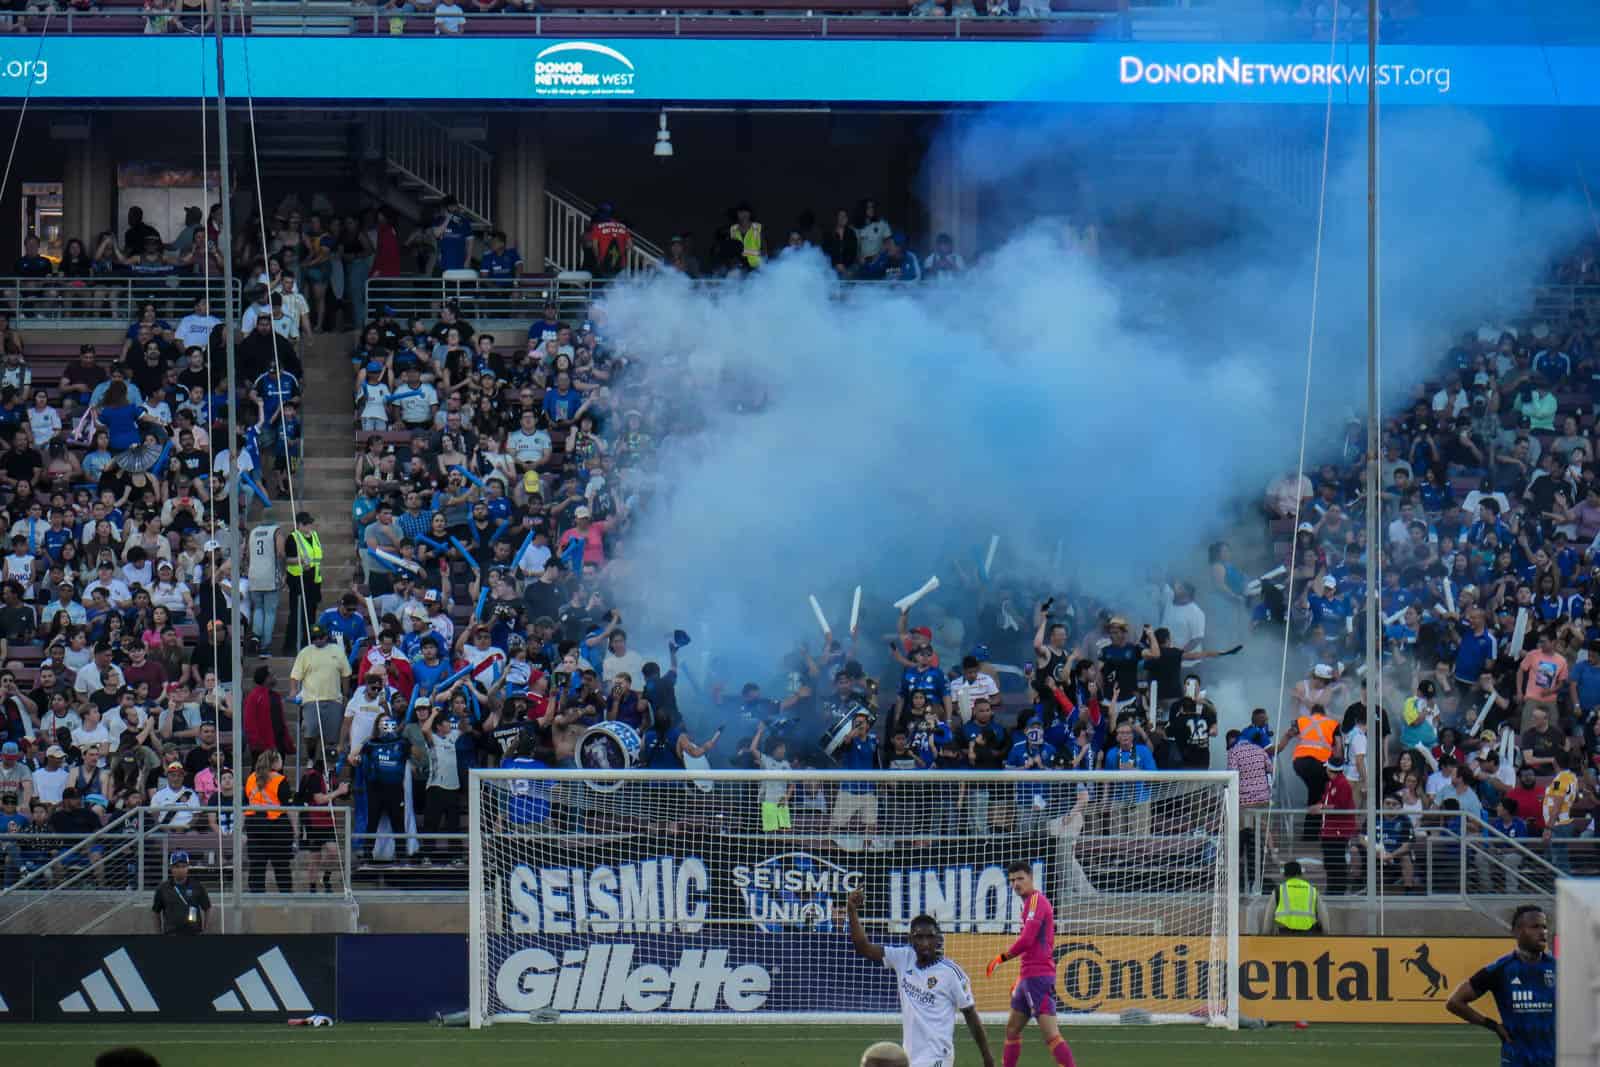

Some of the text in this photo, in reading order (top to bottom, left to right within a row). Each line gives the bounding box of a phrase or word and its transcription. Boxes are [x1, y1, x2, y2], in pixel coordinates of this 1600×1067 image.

[0, 58, 48, 85] .org
[601, 73, 635, 86] WEST
[256, 539, 264, 556] 3
[1186, 718, 1209, 740] 12
[732, 866, 864, 893] SEISMIC
[509, 857, 708, 934] SEISMIC
[495, 944, 772, 1012] Gillette
